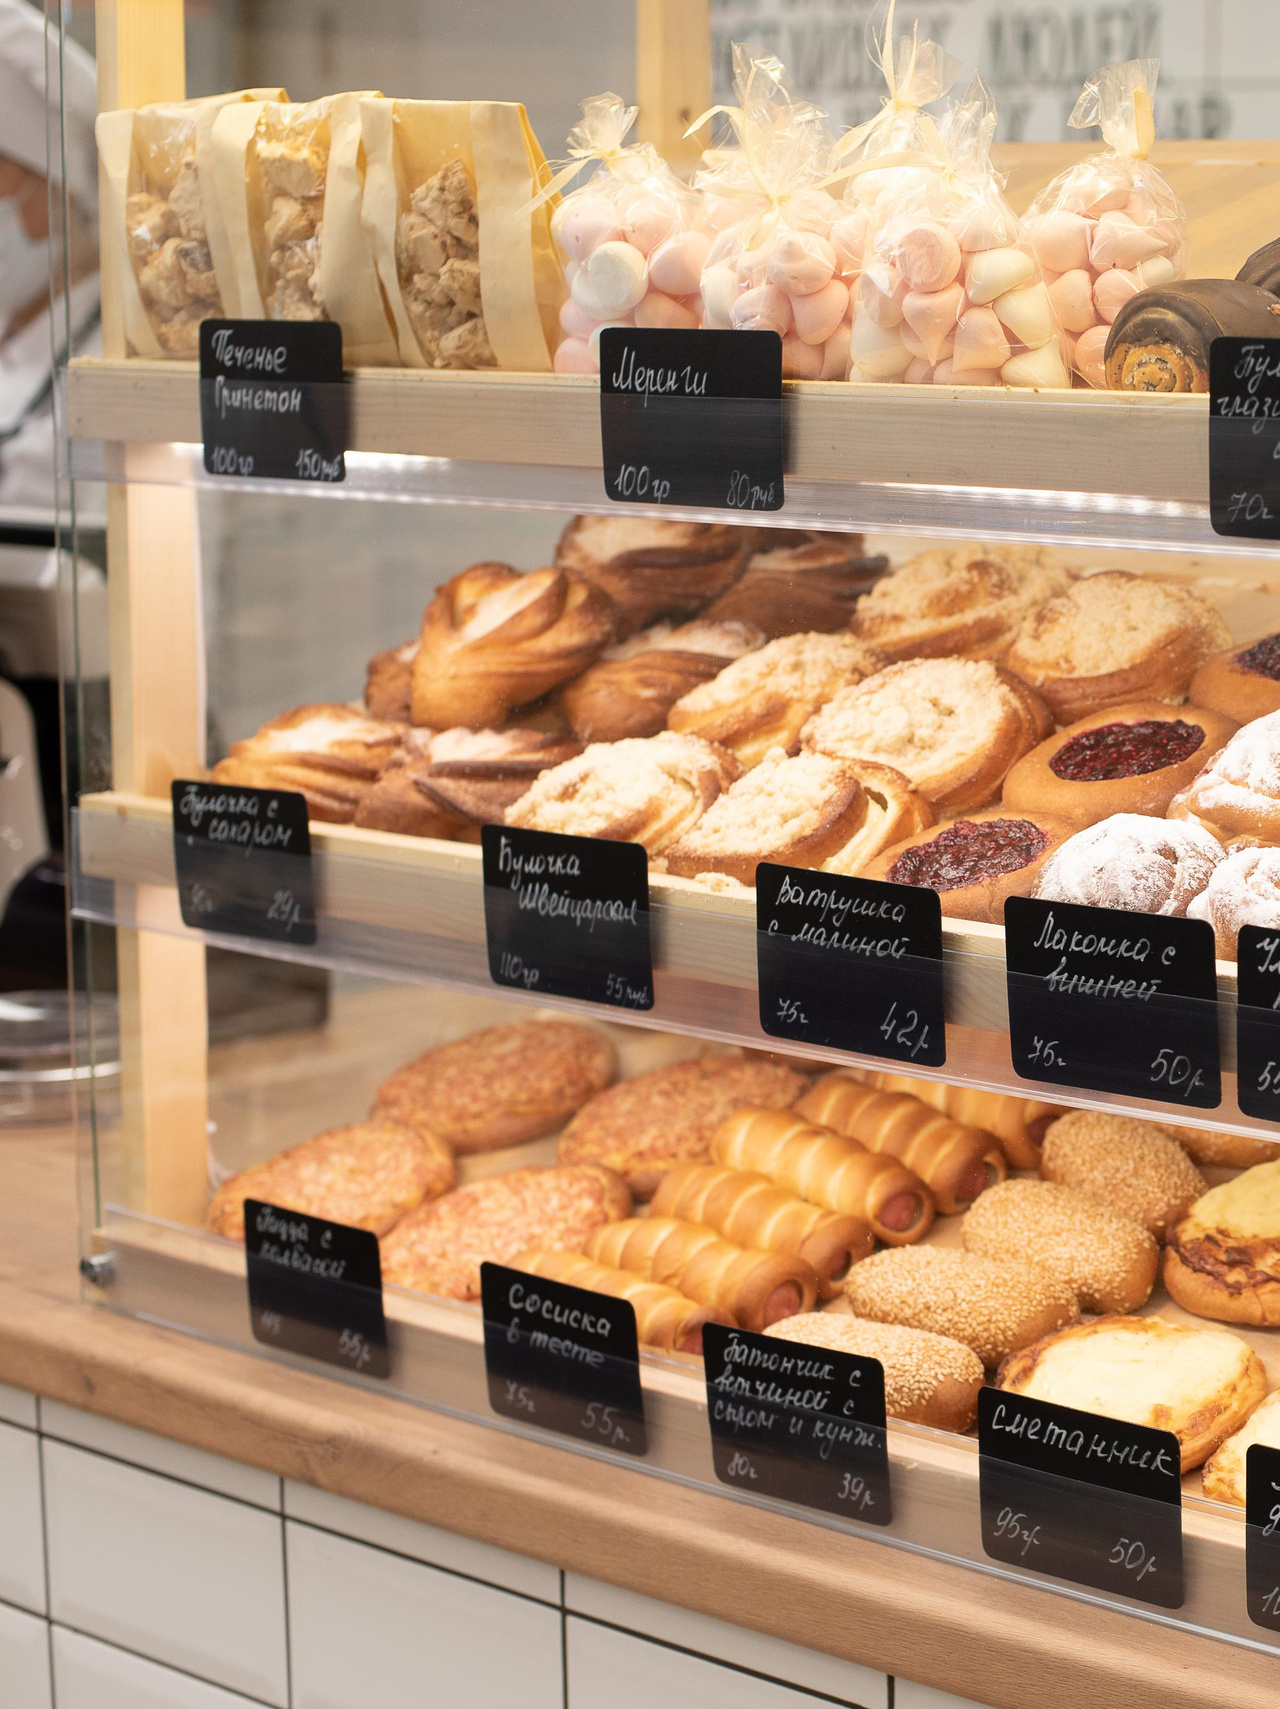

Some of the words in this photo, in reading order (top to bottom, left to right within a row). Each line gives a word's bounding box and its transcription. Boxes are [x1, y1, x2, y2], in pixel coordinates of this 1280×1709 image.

[211, 329, 287, 373] Печенье
[612, 346, 708, 408] Меренги
[267, 798, 279, 818] с
[499, 835, 581, 891] Булочка
[775, 874, 906, 927] Ватрушка
[767, 919, 778, 936] с
[791, 923, 910, 959] малиной
[1033, 911, 1150, 962] Лакомка
[1161, 946, 1177, 965] с
[508, 1283, 612, 1337] Сосиска
[506, 1316, 520, 1344] в
[529, 1330, 605, 1368] тесте
[724, 1333, 835, 1380] Батончик
[849, 1369, 862, 1387] с
[789, 1416, 803, 1434] и
[843, 1400, 854, 1415] с
[992, 1404, 1175, 1477] Сметанник
